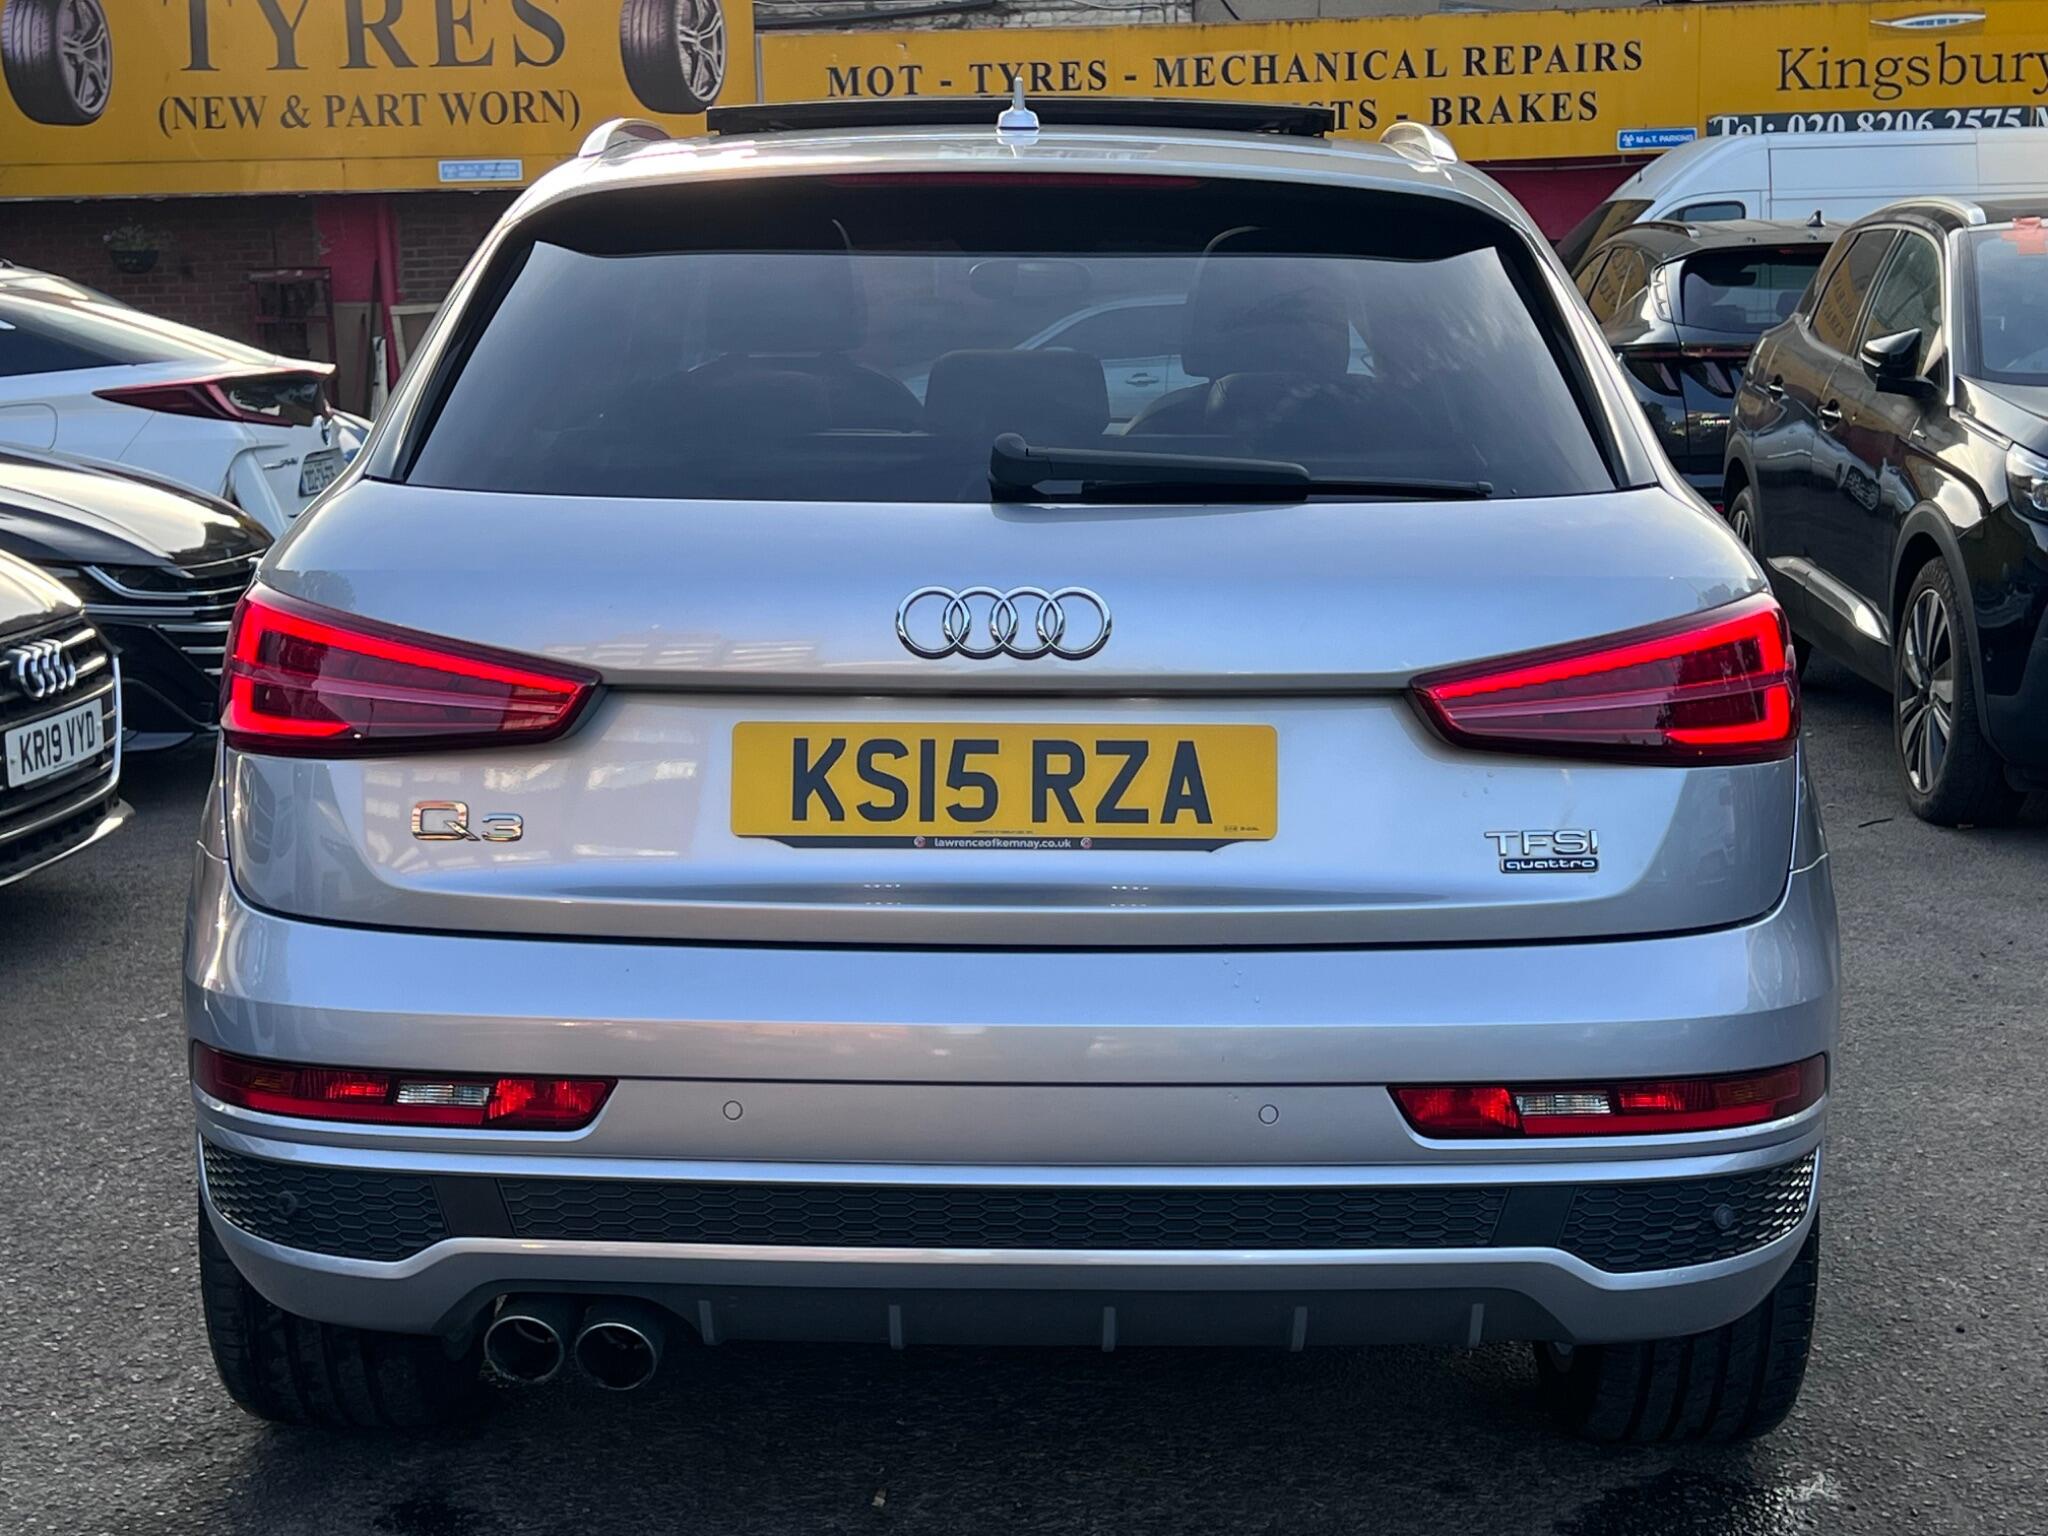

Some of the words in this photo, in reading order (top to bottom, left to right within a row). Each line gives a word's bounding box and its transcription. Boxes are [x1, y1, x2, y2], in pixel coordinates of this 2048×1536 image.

[161, 0, 566, 71] TYRES
[825, 64, 923, 98] MOT
[969, 59, 1107, 95] TYRES
[1153, 48, 1448, 88] MECHANICAL
[1462, 40, 1643, 78] REPAIRS
[159, 94, 267, 139] (NEW
[279, 94, 312, 129] &
[323, 93, 427, 128] PART
[437, 89, 580, 132] WORN)
[1430, 90, 1598, 128] BRAKES
[19, 723, 63, 775] KR19
[66, 710, 95, 757] VYD
[792, 738, 999, 822] KS15
[1031, 740, 1213, 824] RZA
[934, 837, 1072, 850] lawrenceofkemnay.co.uk
[1484, 829, 1599, 856] TFSI
[1505, 859, 1595, 870] quattro
